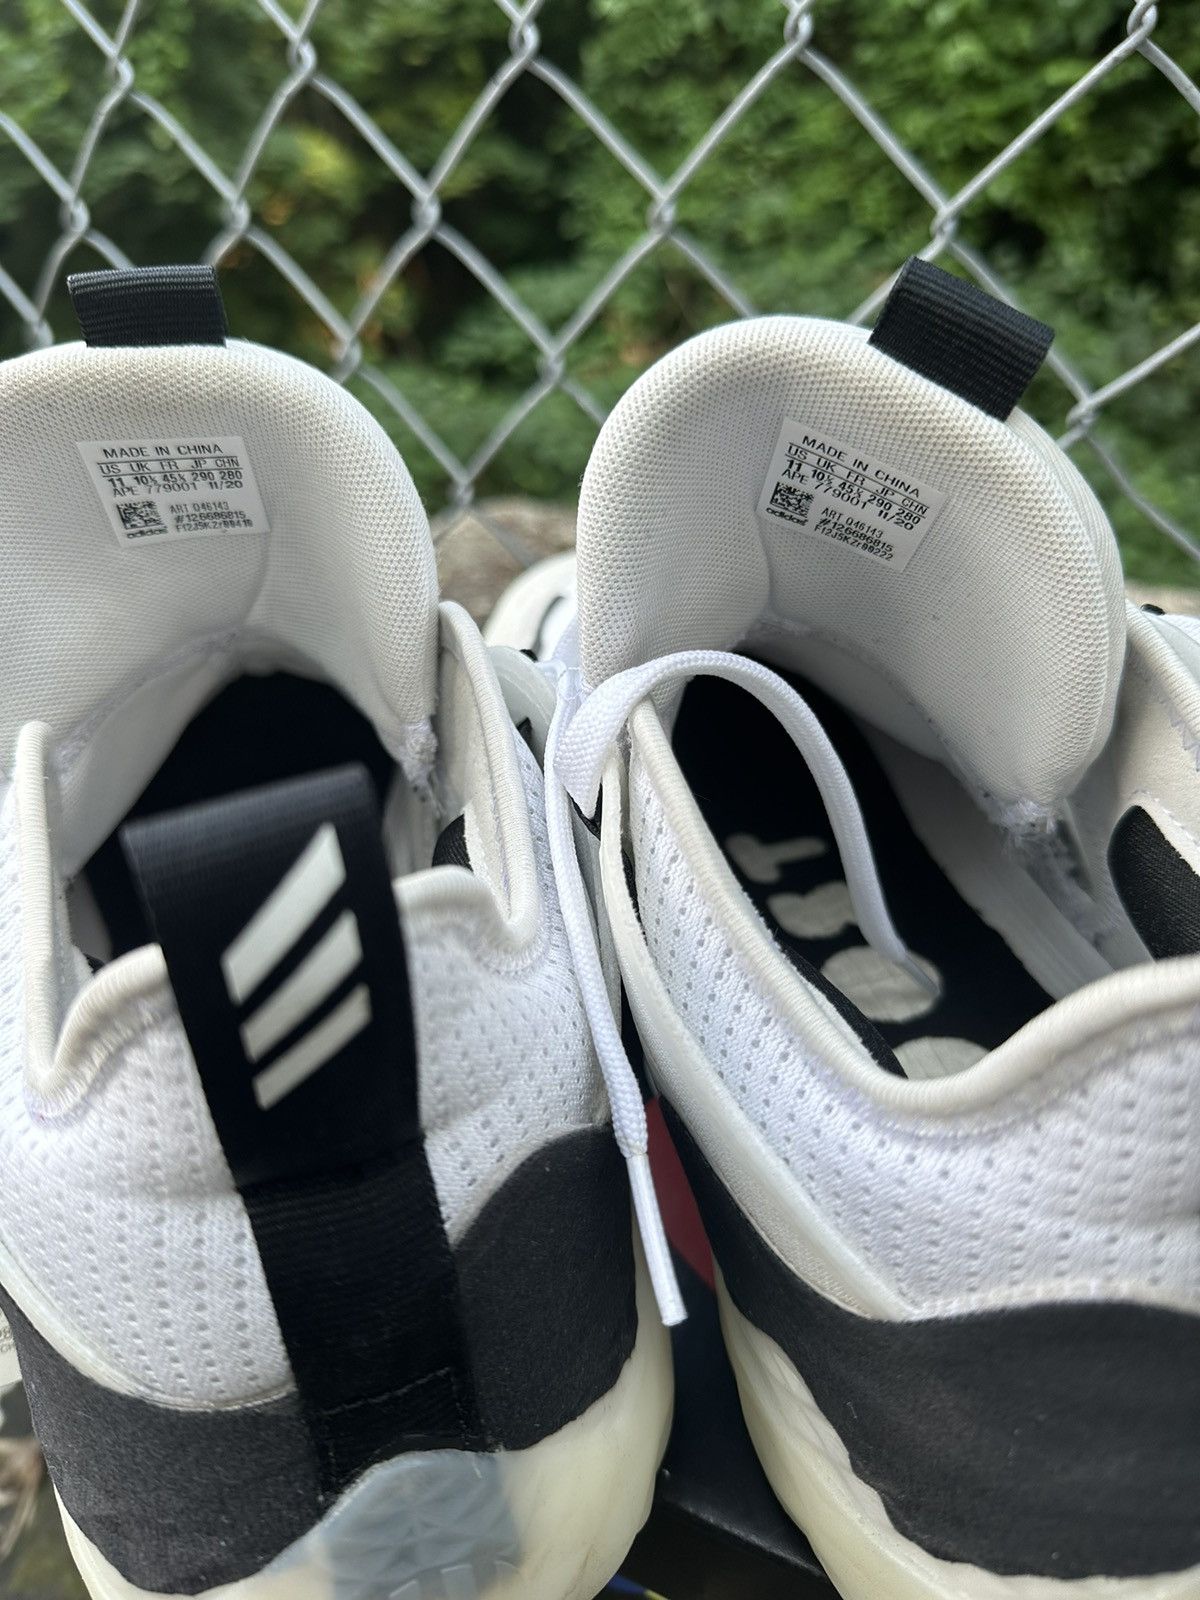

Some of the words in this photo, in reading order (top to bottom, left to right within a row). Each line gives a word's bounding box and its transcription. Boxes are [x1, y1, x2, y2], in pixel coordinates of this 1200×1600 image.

[103, 447, 150, 459] MADE
[155, 445, 170, 456] IN
[177, 443, 223, 455] CHINA
[99, 463, 121, 475] US
[130, 461, 151, 472] UK
[159, 459, 179, 471] FR
[191, 458, 207, 469] JP
[215, 457, 240, 468] CHN
[802, 435, 847, 463] MADE
[853, 458, 869, 472] IN
[874, 469, 920, 498] CHINA
[107, 477, 125, 488] 11
[191, 471, 215, 482] 290
[219, 470, 243, 481] 280
[787, 444, 808, 461] US
[816, 457, 836, 473] UK
[846, 470, 866, 486] FR
[875, 487, 895, 497] JP
[901, 497, 928, 515] CHN
[113, 486, 141, 497] APE
[781, 468, 809, 486] APE
[814, 481, 869, 510] 779001
[878, 509, 914, 531] 11/20
[786, 459, 803, 472] 11
[867, 494, 893, 511] 290
[896, 507, 921, 525] 280
[766, 507, 809, 527] adidas
[821, 507, 844, 522] ART
